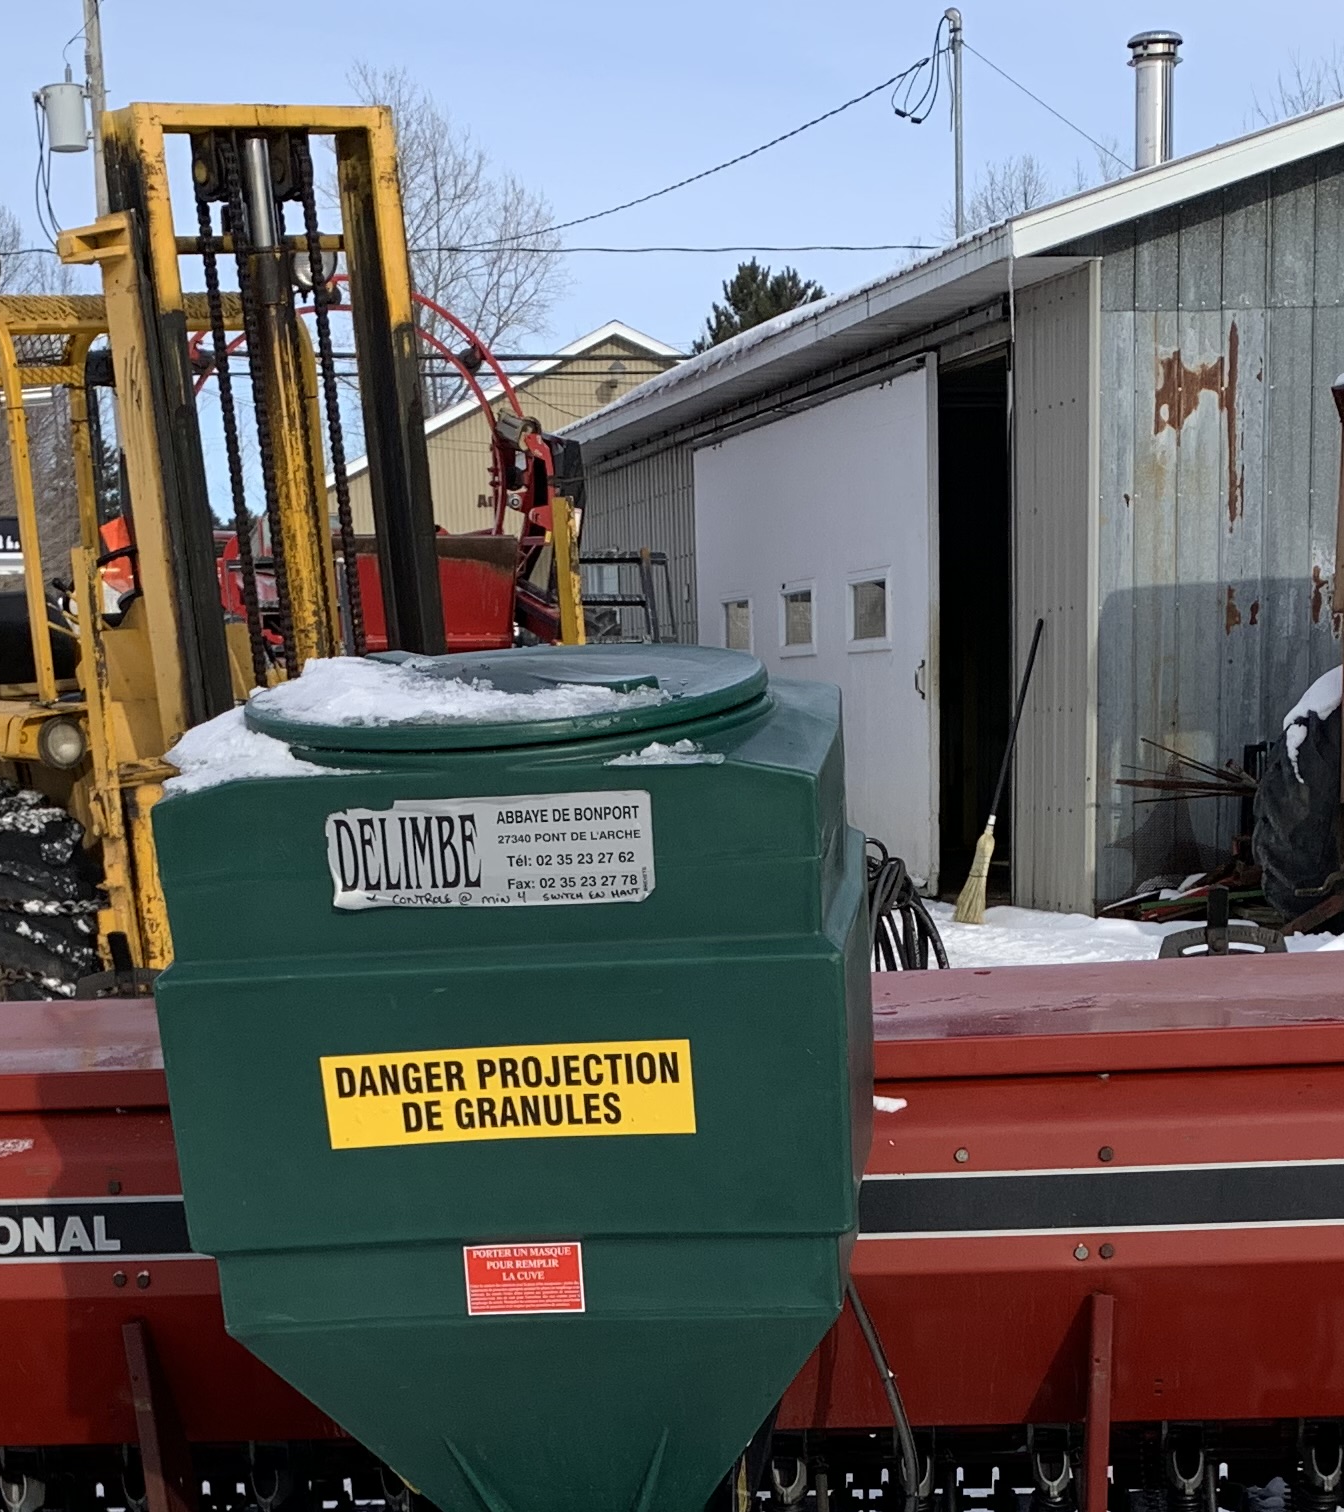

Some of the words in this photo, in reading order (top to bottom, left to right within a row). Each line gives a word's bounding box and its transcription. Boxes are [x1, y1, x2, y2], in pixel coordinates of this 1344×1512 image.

[496, 809, 549, 824] ABBAYE
[552, 808, 571, 822] DE
[574, 805, 640, 821] BONPORT
[497, 834, 531, 844] 27340
[534, 832, 567, 843] PONT
[570, 831, 587, 841] DE
[590, 829, 641, 841] L'ARCHE
[333, 812, 482, 892] DELIMBE
[506, 854, 532, 867] Tél:
[536, 854, 553, 867] 02
[556, 854, 573, 866] 35
[577, 853, 594, 865] 23
[597, 852, 614, 864] 27
[618, 851, 635, 863] 62
[507, 878, 536, 890] Fax:
[539, 877, 556, 889] 02
[559, 877, 576, 888] 35
[580, 876, 597, 887] 23
[600, 875, 617, 886] 27
[621, 874, 638, 886] 78
[611, 887, 640, 898] HAUT
[335, 1061, 467, 1099] DANGER
[477, 1051, 680, 1090] PROJECTION
[401, 1101, 444, 1133] DE
[455, 1092, 623, 1130] GRANULES
[472, 1248, 511, 1259] PORTER
[513, 1248, 528, 1257] UN
[530, 1246, 572, 1258] MASQUE
[486, 1260, 514, 1270] POUR
[515, 1259, 560, 1269] REMPLIR
[502, 1272, 515, 1281] LA
[516, 1271, 545, 1280] CUVE
